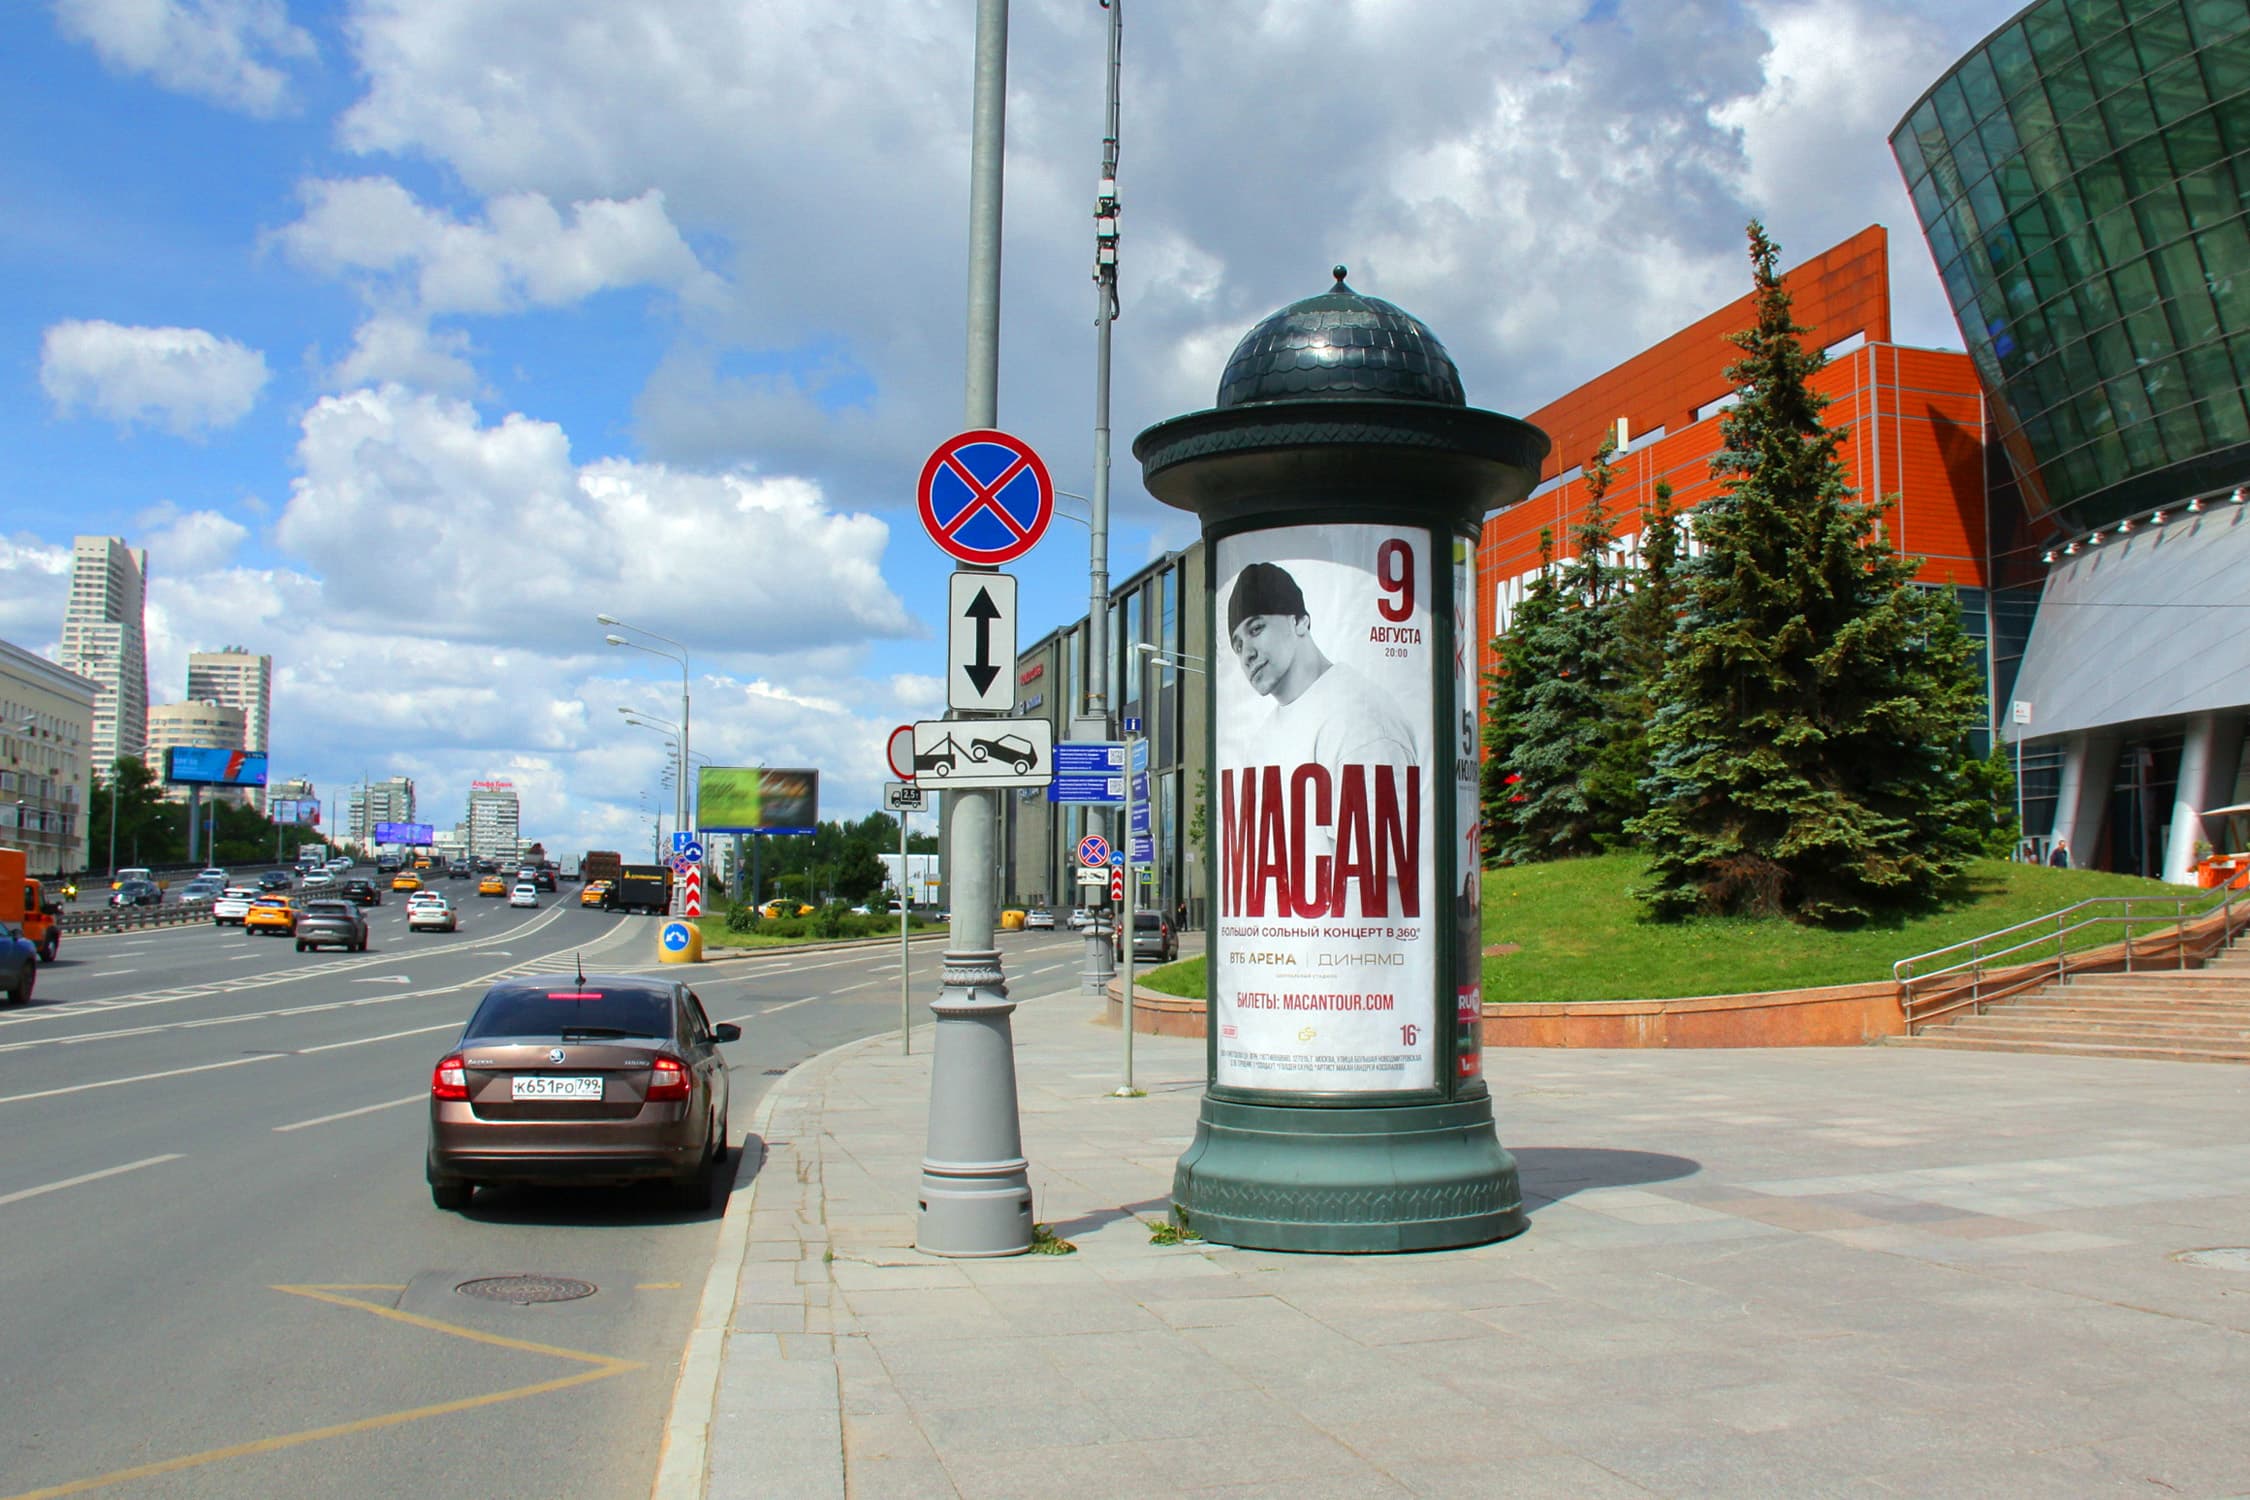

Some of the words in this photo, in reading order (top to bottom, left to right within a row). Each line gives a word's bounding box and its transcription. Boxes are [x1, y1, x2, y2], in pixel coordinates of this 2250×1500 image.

[1377, 538, 1415, 622] 9
[1370, 626, 1421, 645] АВГУСТА
[1385, 648, 1408, 658] 20:00
[1461, 709, 1473, 756] 5
[1222, 763, 1420, 919] MACAN
[1221, 925, 1259, 937] БОЛЬШОЙ
[1262, 926, 1319, 938] СОЛЬНЫЙ
[1323, 928, 1383, 939] КОНЦЕРТ
[1386, 928, 1394, 938] В
[1230, 952, 1246, 964] ВТБ
[1249, 953, 1296, 965] АРЕНА
[1318, 953, 1404, 966] ДИНАМО
[1237, 992, 1280, 1010] БИЛЕТЫ:
[1283, 993, 1394, 1011] MACANTOUR.COM
